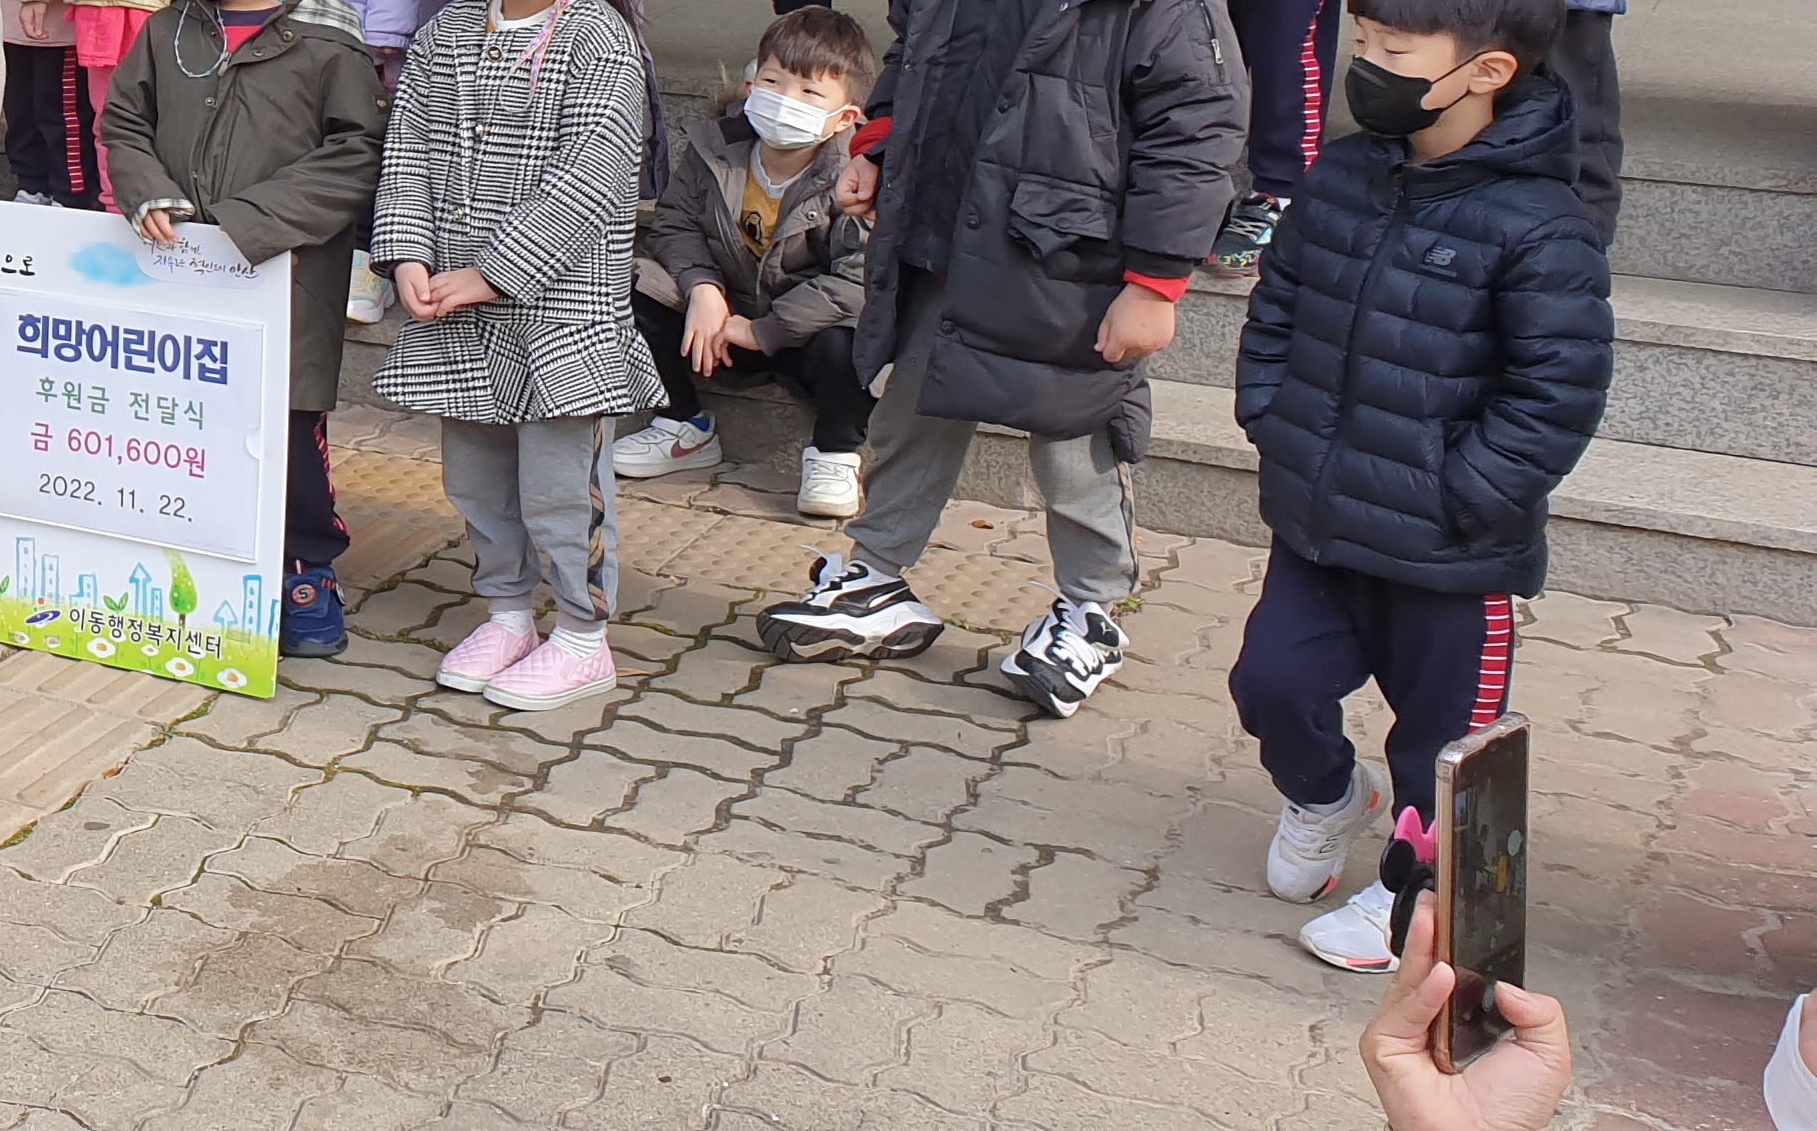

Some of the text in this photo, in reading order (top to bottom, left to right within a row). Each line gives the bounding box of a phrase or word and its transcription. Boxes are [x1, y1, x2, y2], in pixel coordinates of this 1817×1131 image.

[17, 313, 229, 386] 희망어린이집
[35, 376, 204, 430] 후원금 전달식
[31, 422, 206, 479] 금 601,600원
[39, 473, 193, 522] 2022. 11. 22.
[69, 608, 222, 659] 이동행정복지센터
